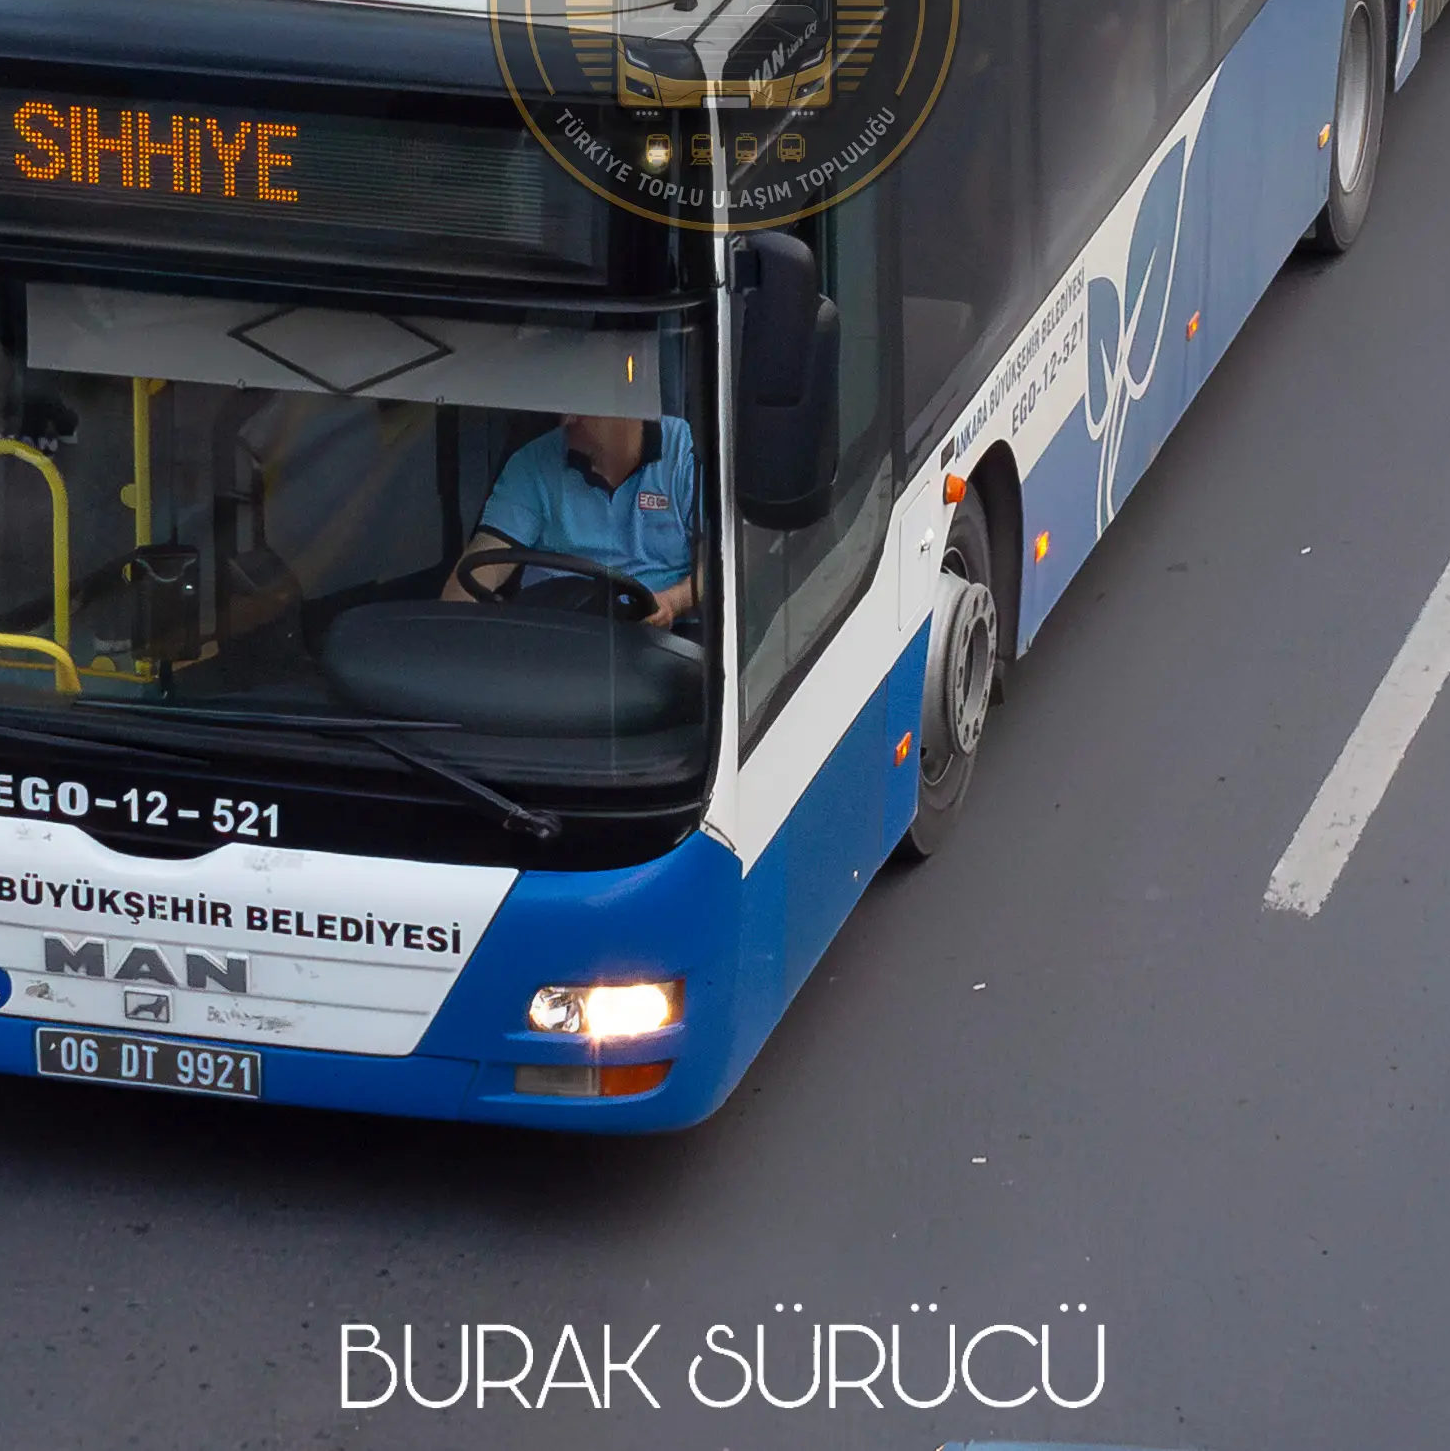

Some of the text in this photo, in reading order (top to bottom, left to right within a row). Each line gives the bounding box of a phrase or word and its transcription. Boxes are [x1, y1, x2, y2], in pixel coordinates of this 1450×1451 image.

[13, 101, 299, 202] SIHHİYE
[1012, 312, 1084, 438] EGO-12-521
[954, 399, 989, 464] ANKARA
[246, 904, 462, 954] BELEDİYESİ
[43, 932, 250, 994] MAN
[60, 1036, 251, 1092] 06 DT 9921
